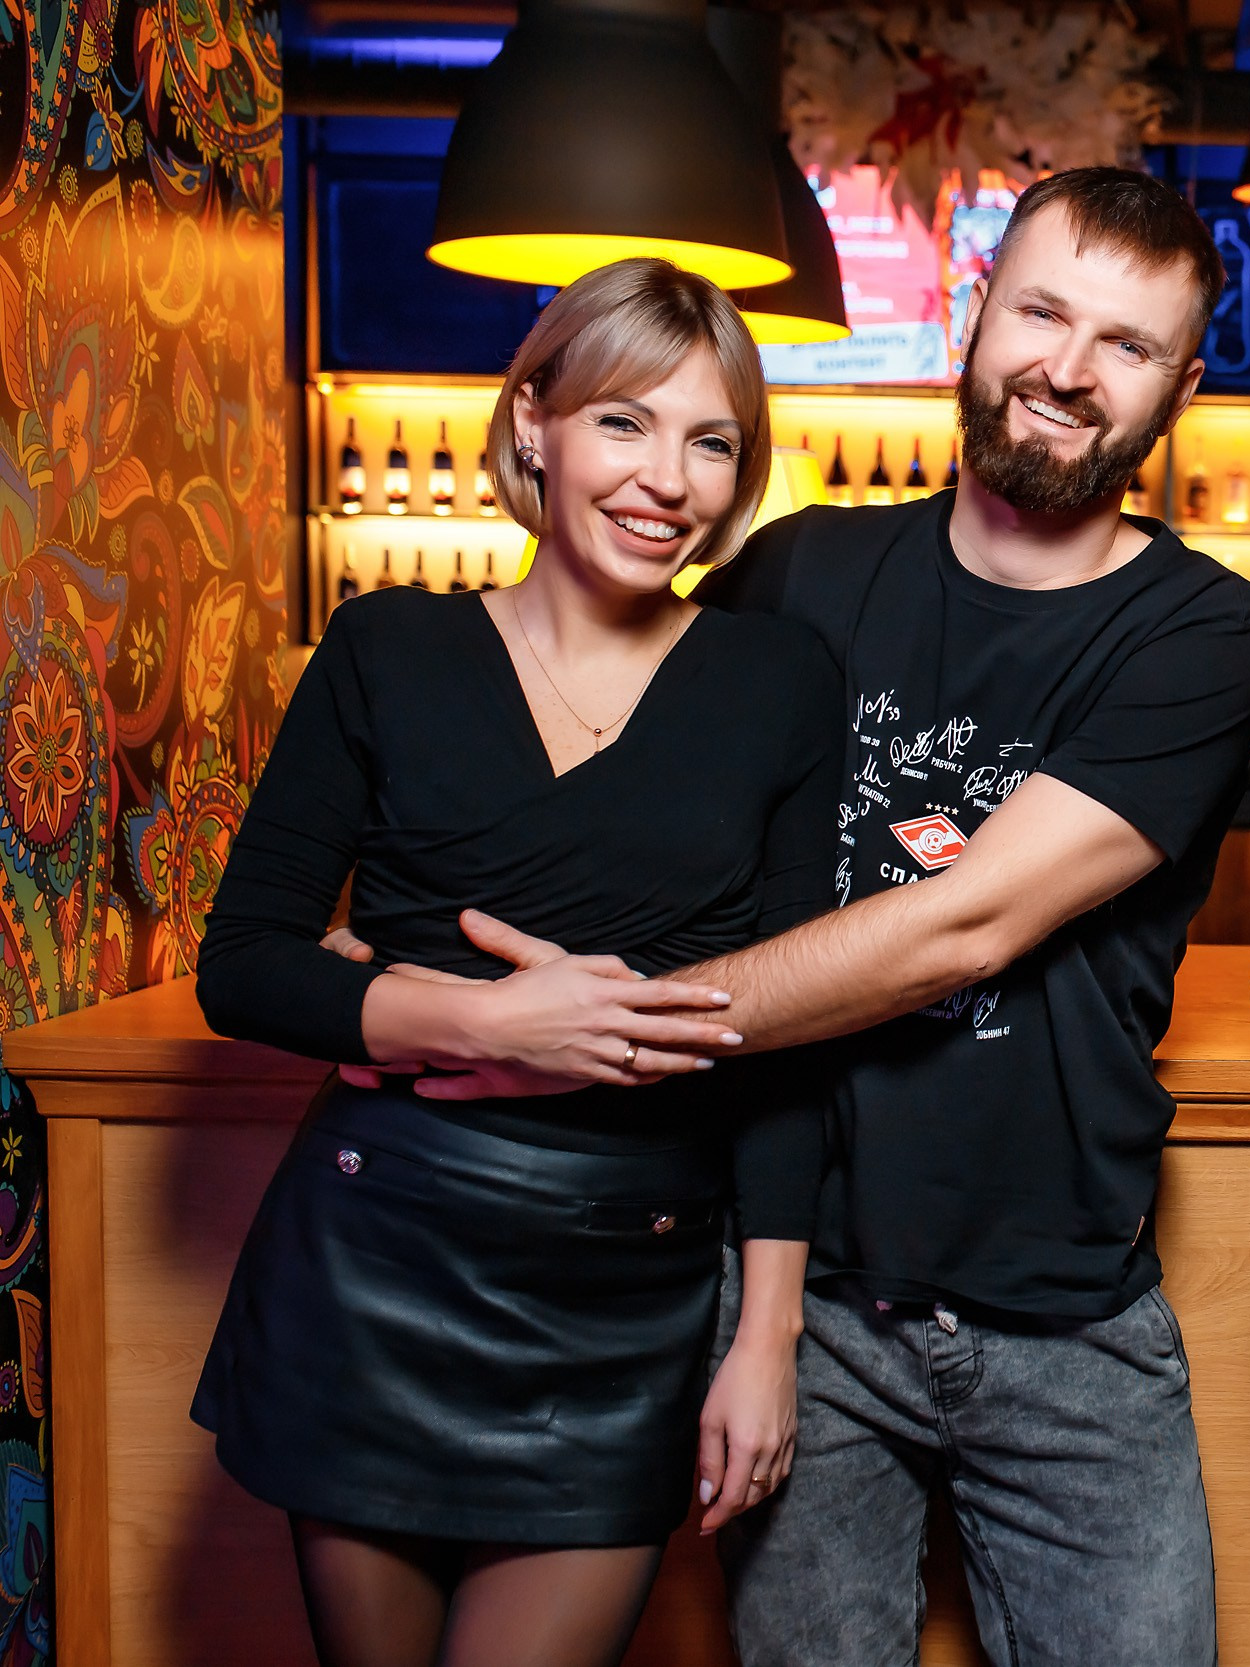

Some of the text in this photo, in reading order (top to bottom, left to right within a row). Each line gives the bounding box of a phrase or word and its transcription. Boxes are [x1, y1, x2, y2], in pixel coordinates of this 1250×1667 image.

[930, 756, 963, 774] РЯБЧУК 2
[900, 766, 924, 780] ДЕНИСОВ
[882, 797, 891, 809] 22
[880, 862, 929, 885] СПА
[919, 1007, 946, 1018] УСЕВИЧ
[976, 1026, 1010, 1040] ЗОБНИН 47
